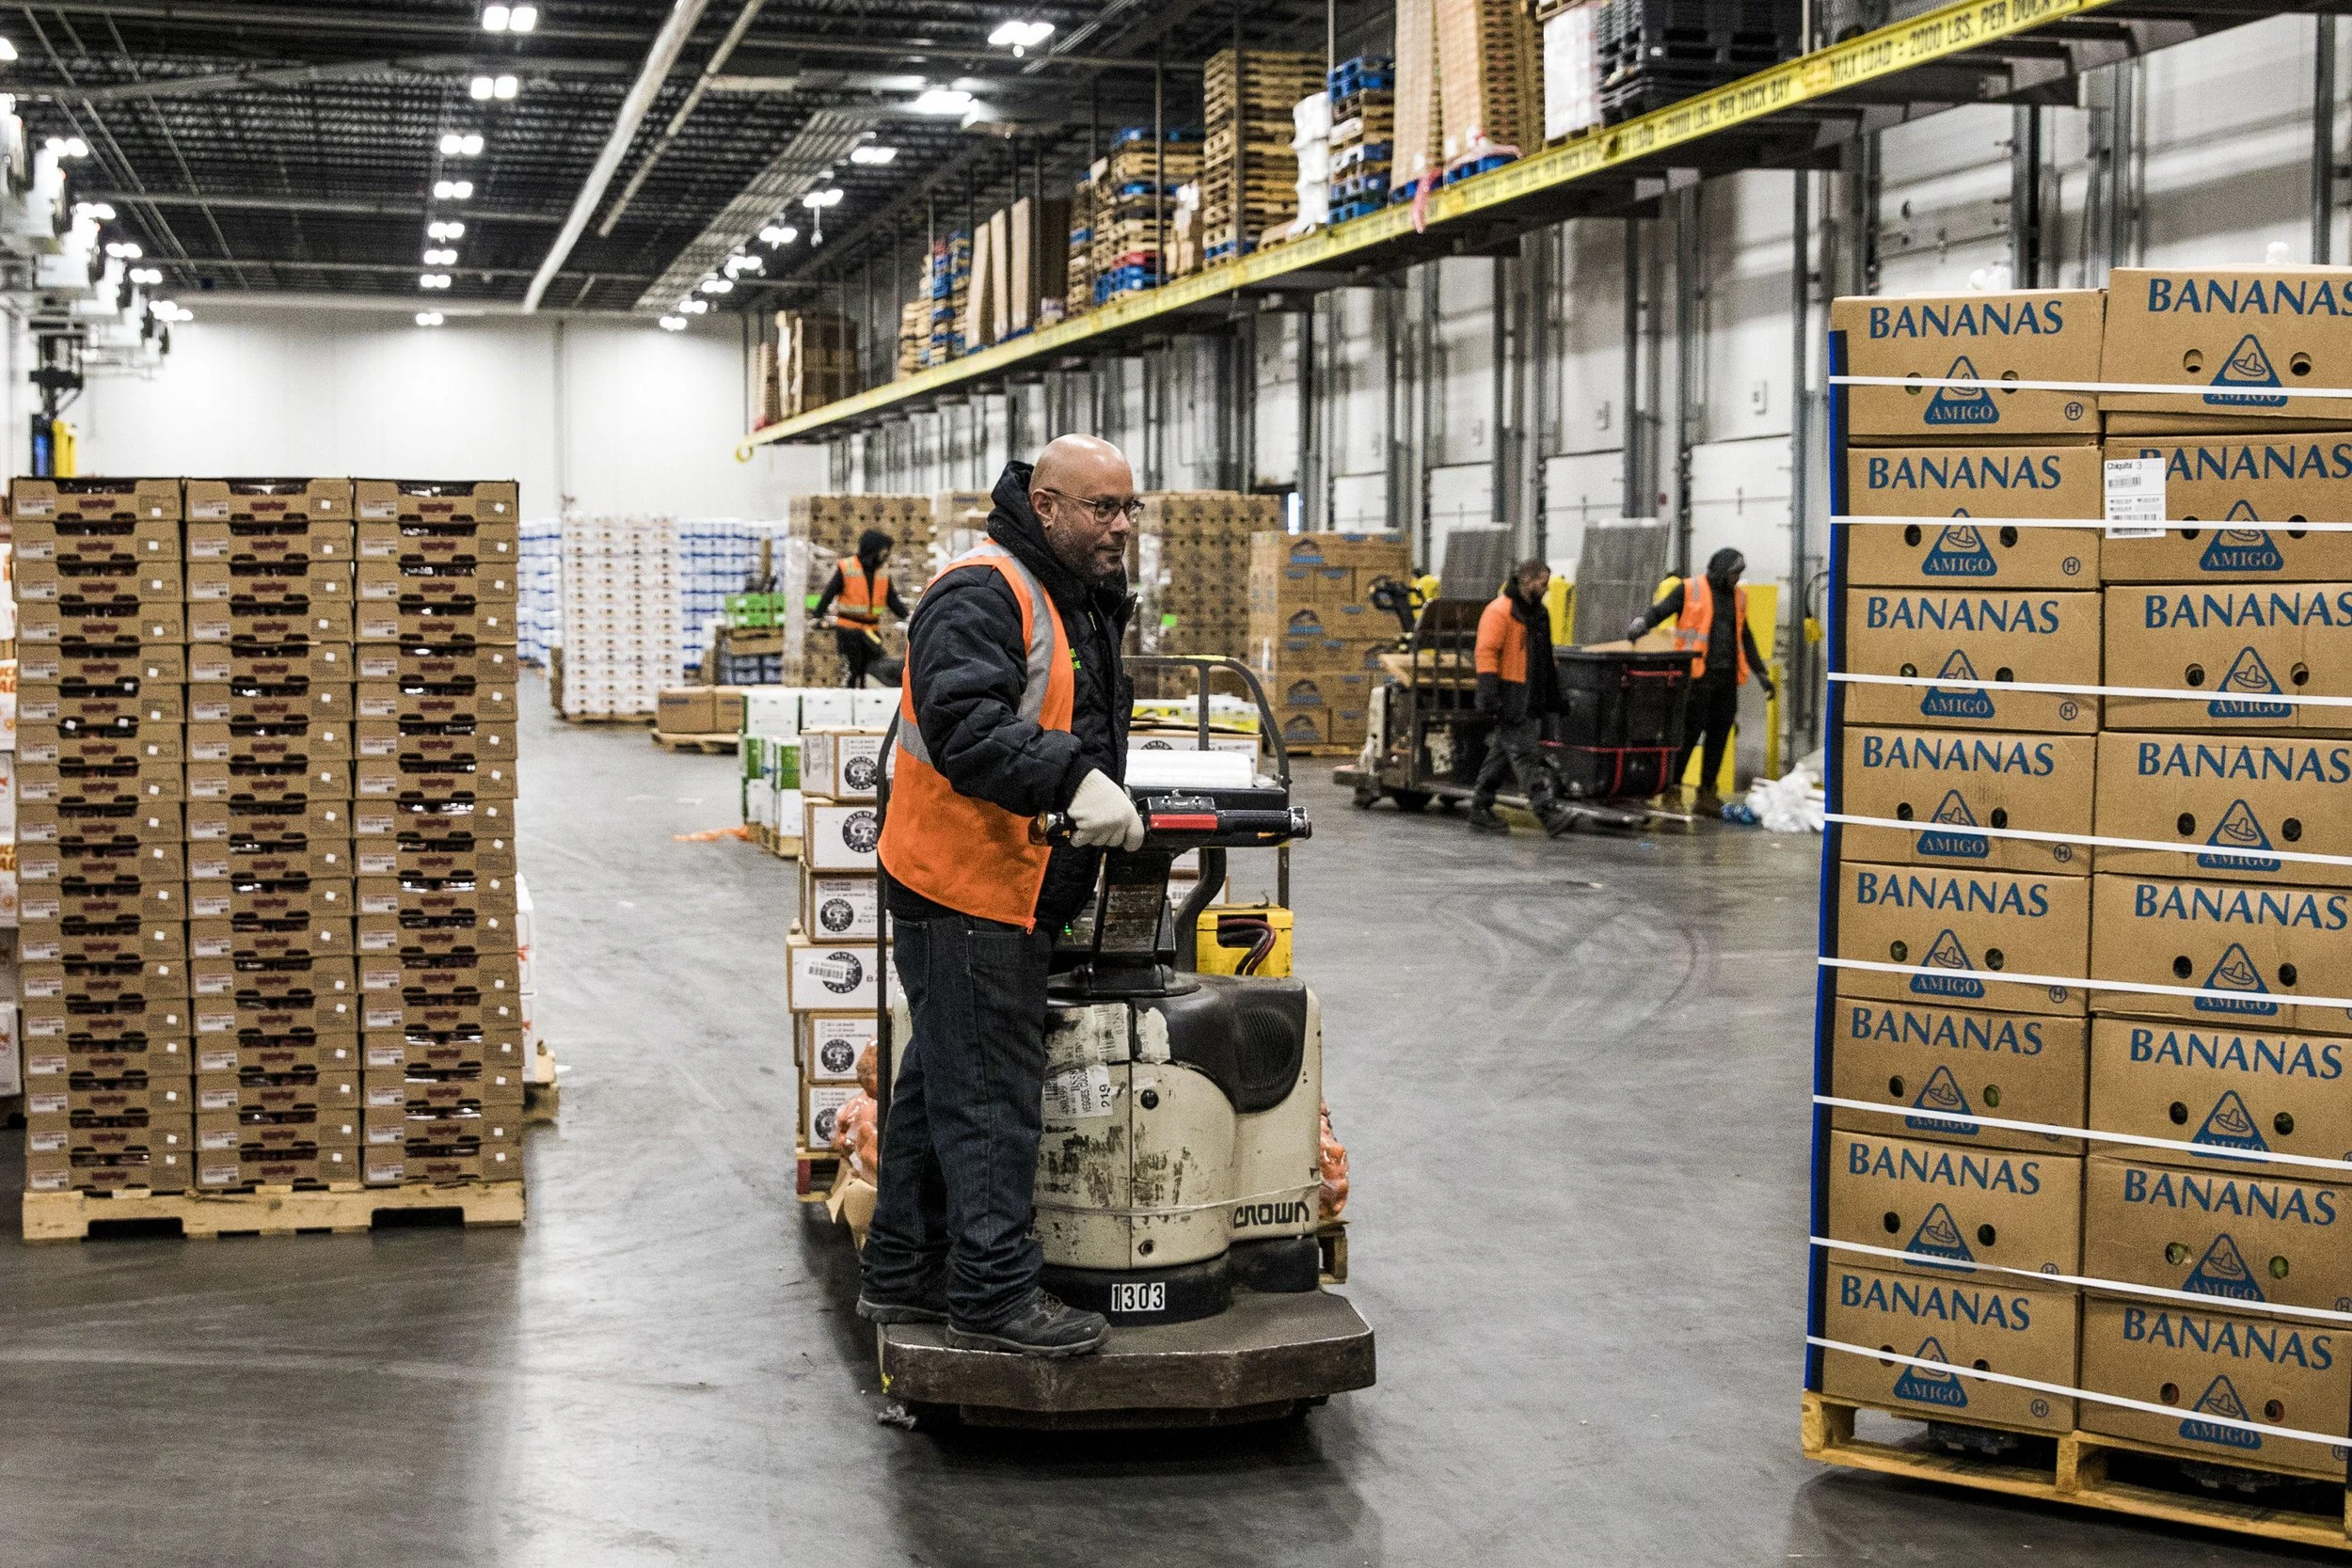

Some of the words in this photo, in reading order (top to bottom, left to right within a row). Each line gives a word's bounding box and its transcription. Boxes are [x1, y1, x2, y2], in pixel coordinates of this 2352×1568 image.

[1980, 1, 2007, 34] PER
[1869, 300, 2063, 339] BANANAS
[1931, 404, 1994, 422] AMIGO
[1868, 455, 2061, 489] BANANAS
[1929, 557, 1992, 575] AMIGO
[2206, 549, 2278, 569] AMIGO
[1867, 596, 2058, 634] BANANAS
[2145, 592, 2352, 628] BANANAS
[1927, 697, 1989, 716] AMIGO
[1863, 736, 2054, 776] BANANAS
[2138, 742, 2350, 784] BANANAS
[1923, 837, 1985, 856] AMIGO
[1858, 872, 2049, 917] BANANAS
[2135, 884, 2348, 930] BANANAS
[1916, 977, 1979, 997] AMIGO
[1852, 1006, 2042, 1055] BANANAS
[2130, 1028, 2343, 1080] BANANAS
[1099, 1084, 1110, 1108] 219
[1849, 1142, 2041, 1196] BANANAS
[2124, 1168, 2337, 1226] BANANAS
[1114, 1284, 1163, 1309] 1303
[1841, 1275, 2030, 1332] BANANAS
[2123, 1307, 2333, 1370] BANANAS
[1901, 1382, 1963, 1403] AMIGO
[2186, 1422, 2256, 1448] AMIGO
